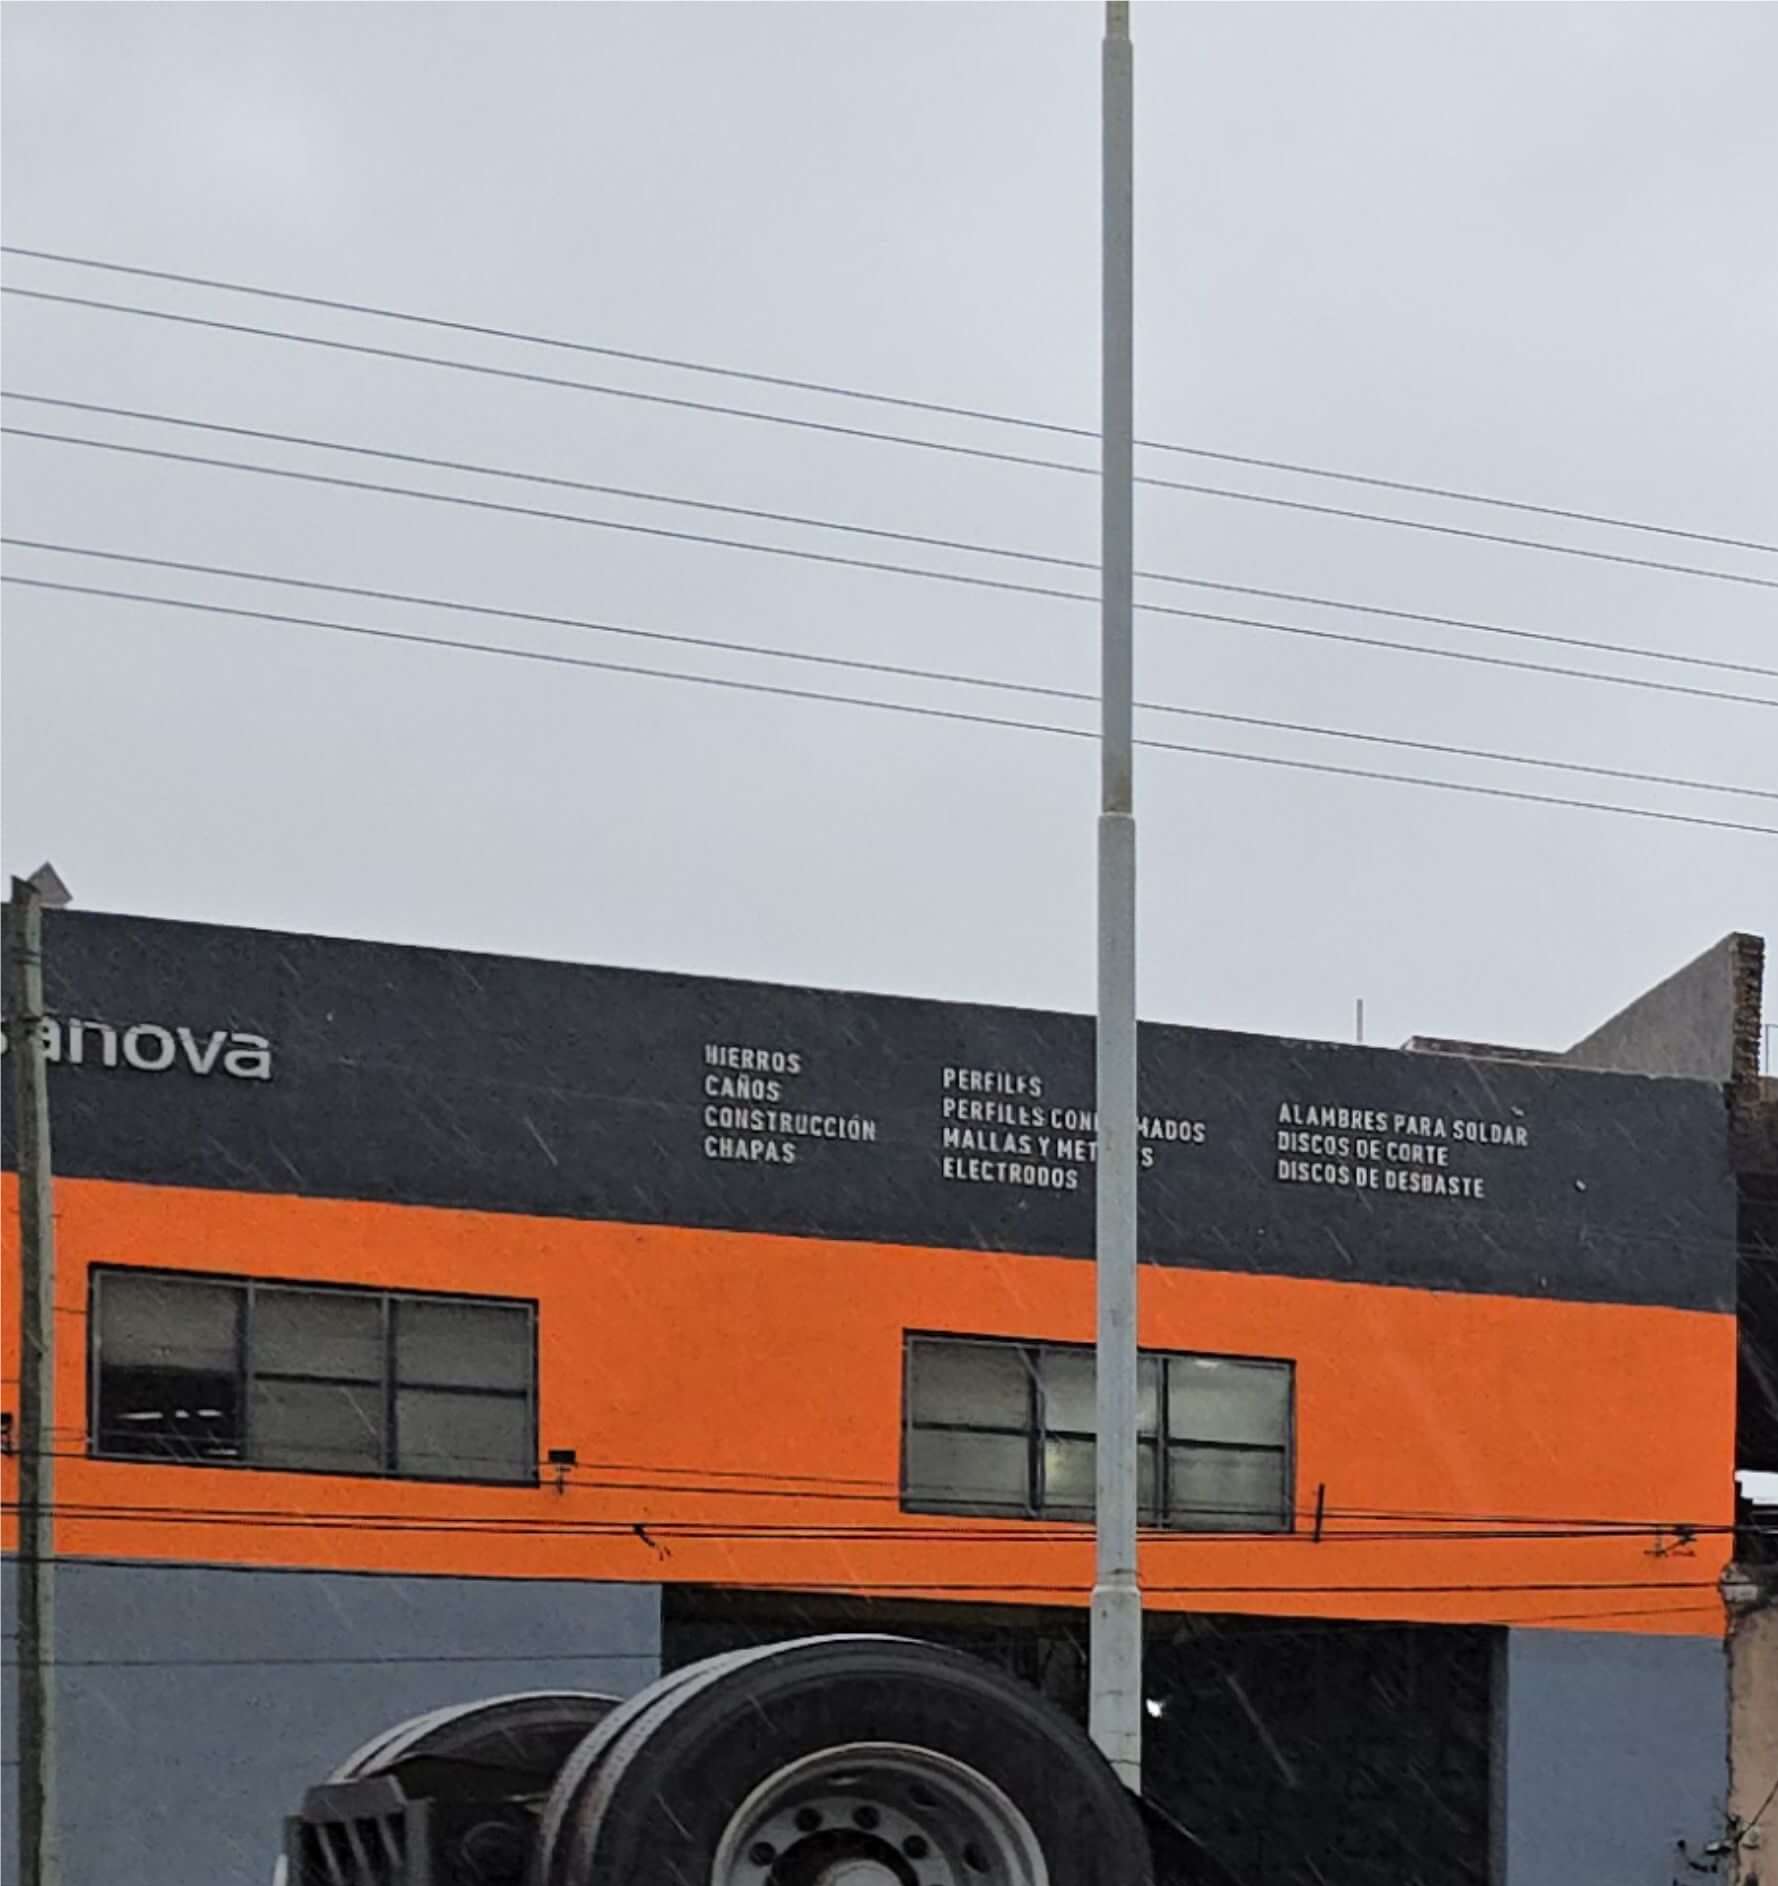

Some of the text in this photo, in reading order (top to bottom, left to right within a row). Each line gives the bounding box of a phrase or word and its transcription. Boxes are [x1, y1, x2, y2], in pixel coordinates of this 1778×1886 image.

[0, 1011, 272, 1080] nova
[704, 1043, 802, 1074] HIERROS
[704, 1074, 782, 1102] CAÑOS
[942, 1067, 1042, 1097] PERFILES
[704, 1104, 877, 1141] CONSTRUCCIÓN
[942, 1096, 1206, 1143] PERFILES CONMADOS
[1278, 1101, 1529, 1147] ALAMBRES PARA SOLDAR
[704, 1135, 798, 1164] CHAPAS
[942, 1127, 1154, 1167] MALLAS Y METS
[1277, 1131, 1449, 1167] DISCOS DE CORTE
[942, 1156, 1079, 1189] ELECTRODOS
[1278, 1159, 1485, 1198] DISCOS DE DESBASTE
